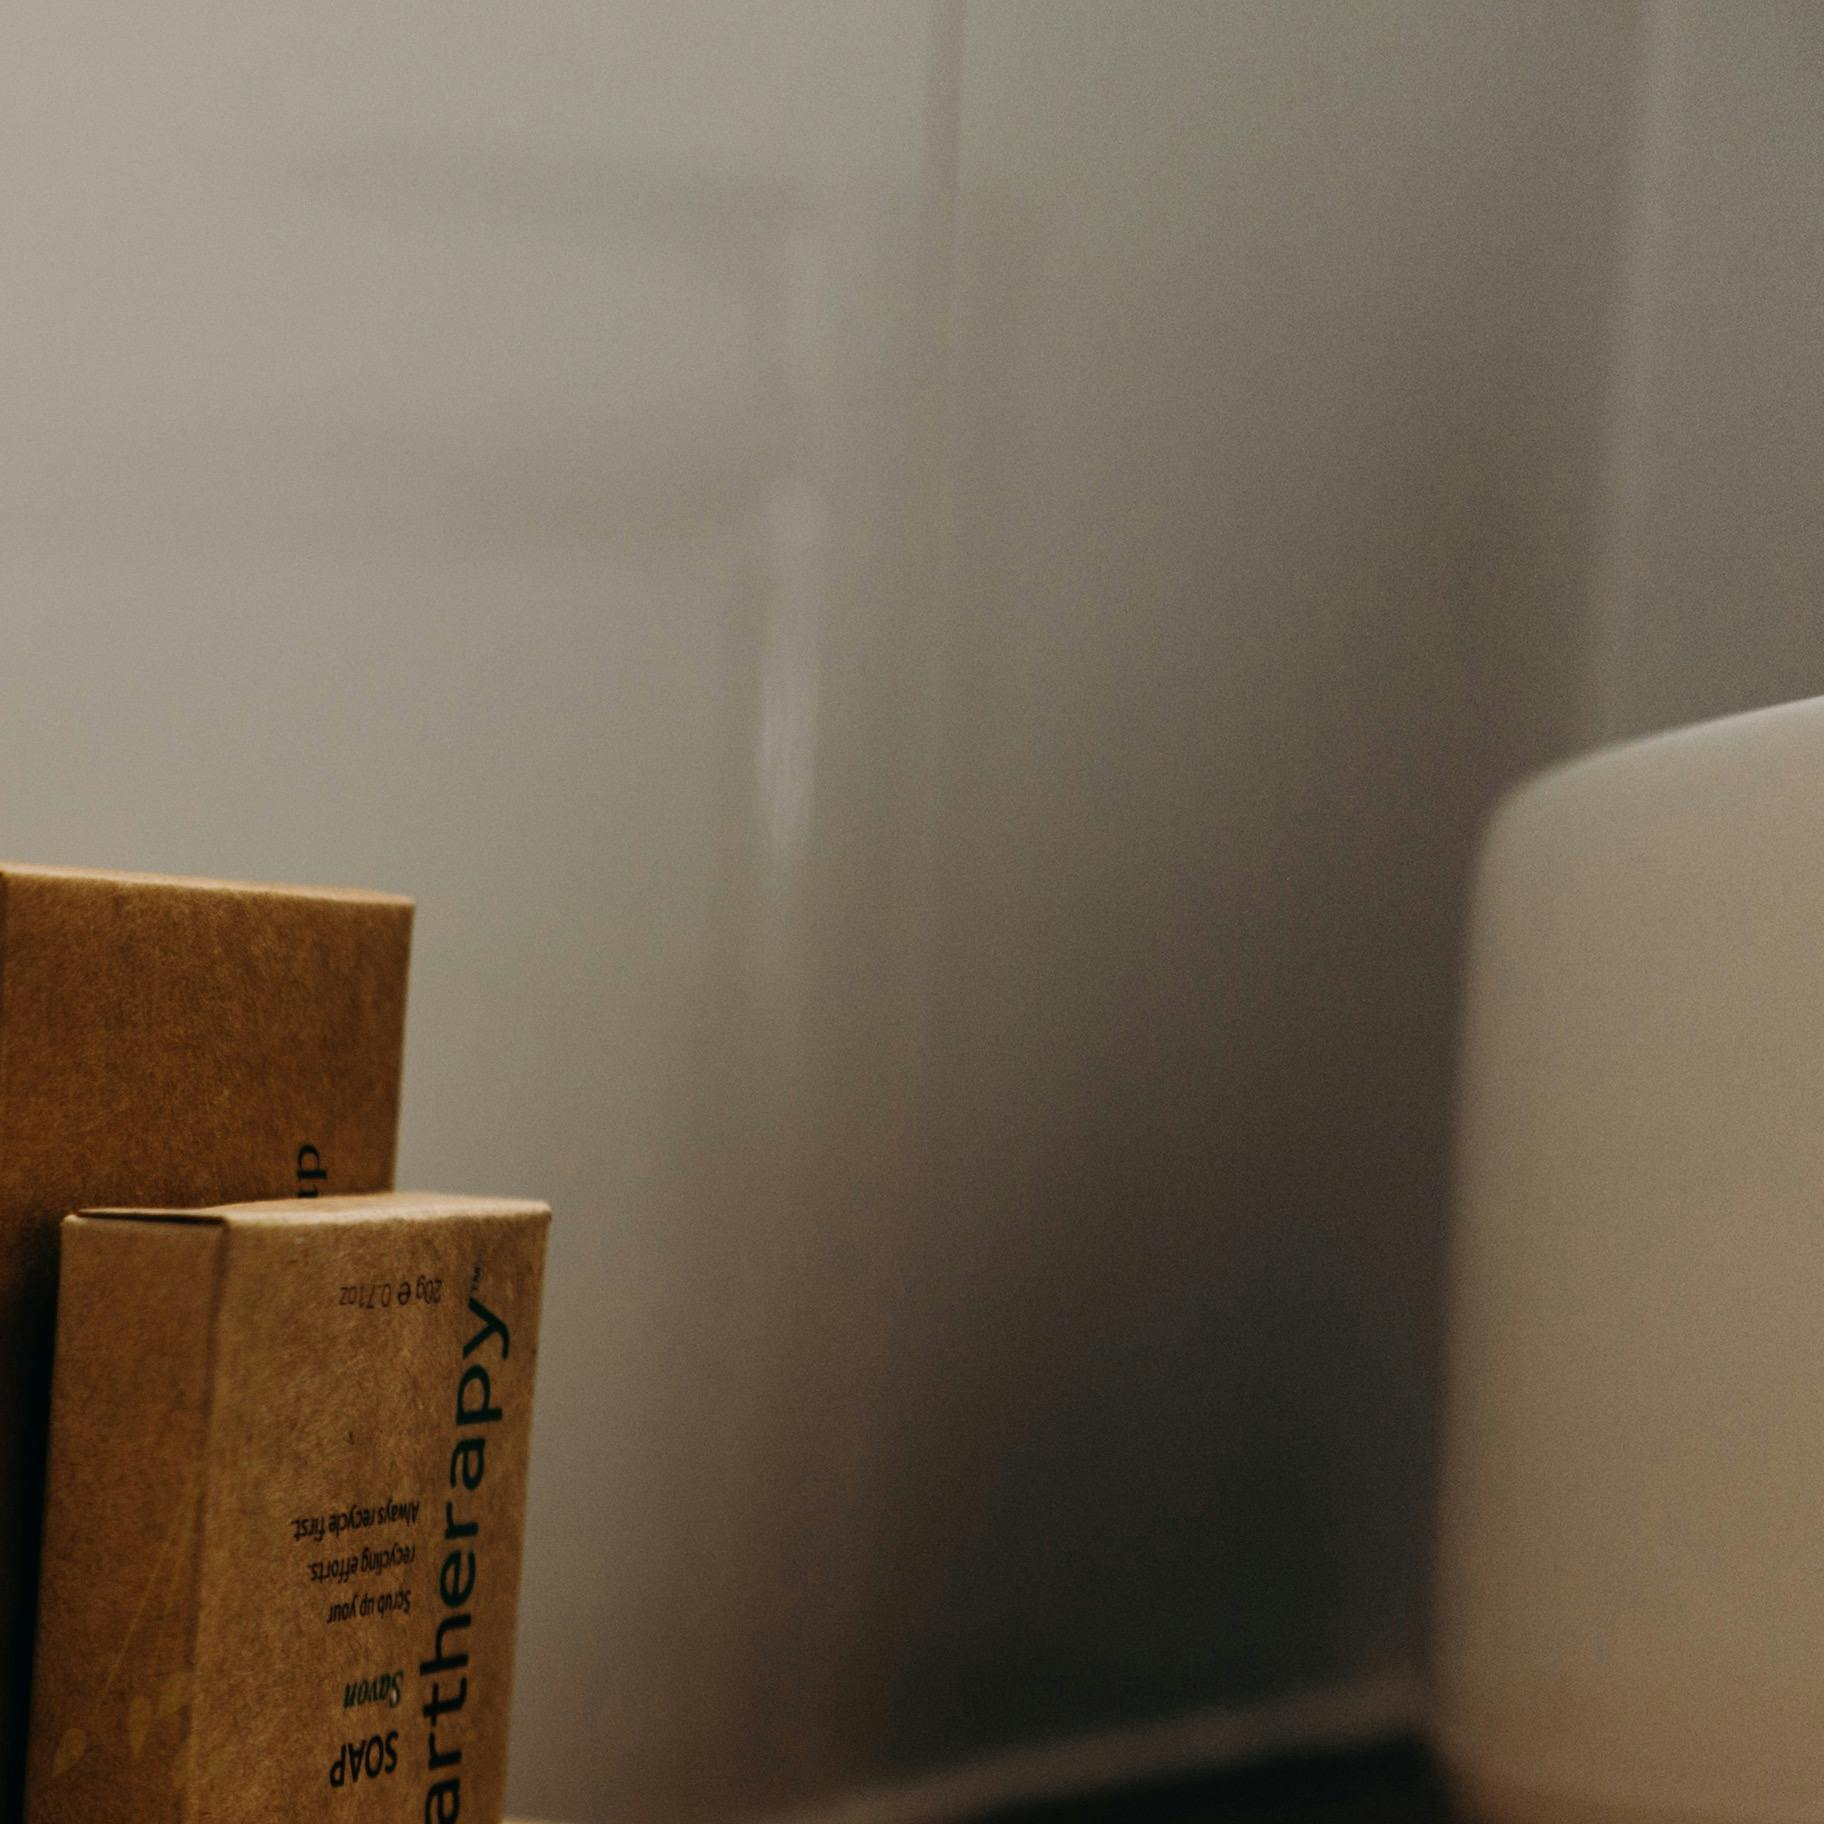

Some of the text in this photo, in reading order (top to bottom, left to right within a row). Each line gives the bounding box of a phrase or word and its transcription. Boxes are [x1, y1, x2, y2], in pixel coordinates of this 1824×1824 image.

[415, 1275, 443, 1305] 20g
[328, 1503, 376, 1538] recycle
[377, 1499, 420, 1528] Always
[361, 1541, 416, 1572] recycling
[326, 1589, 412, 1624] Scrub up your
[342, 1670, 405, 1710] Savon
[329, 1731, 399, 1788] SOAP
